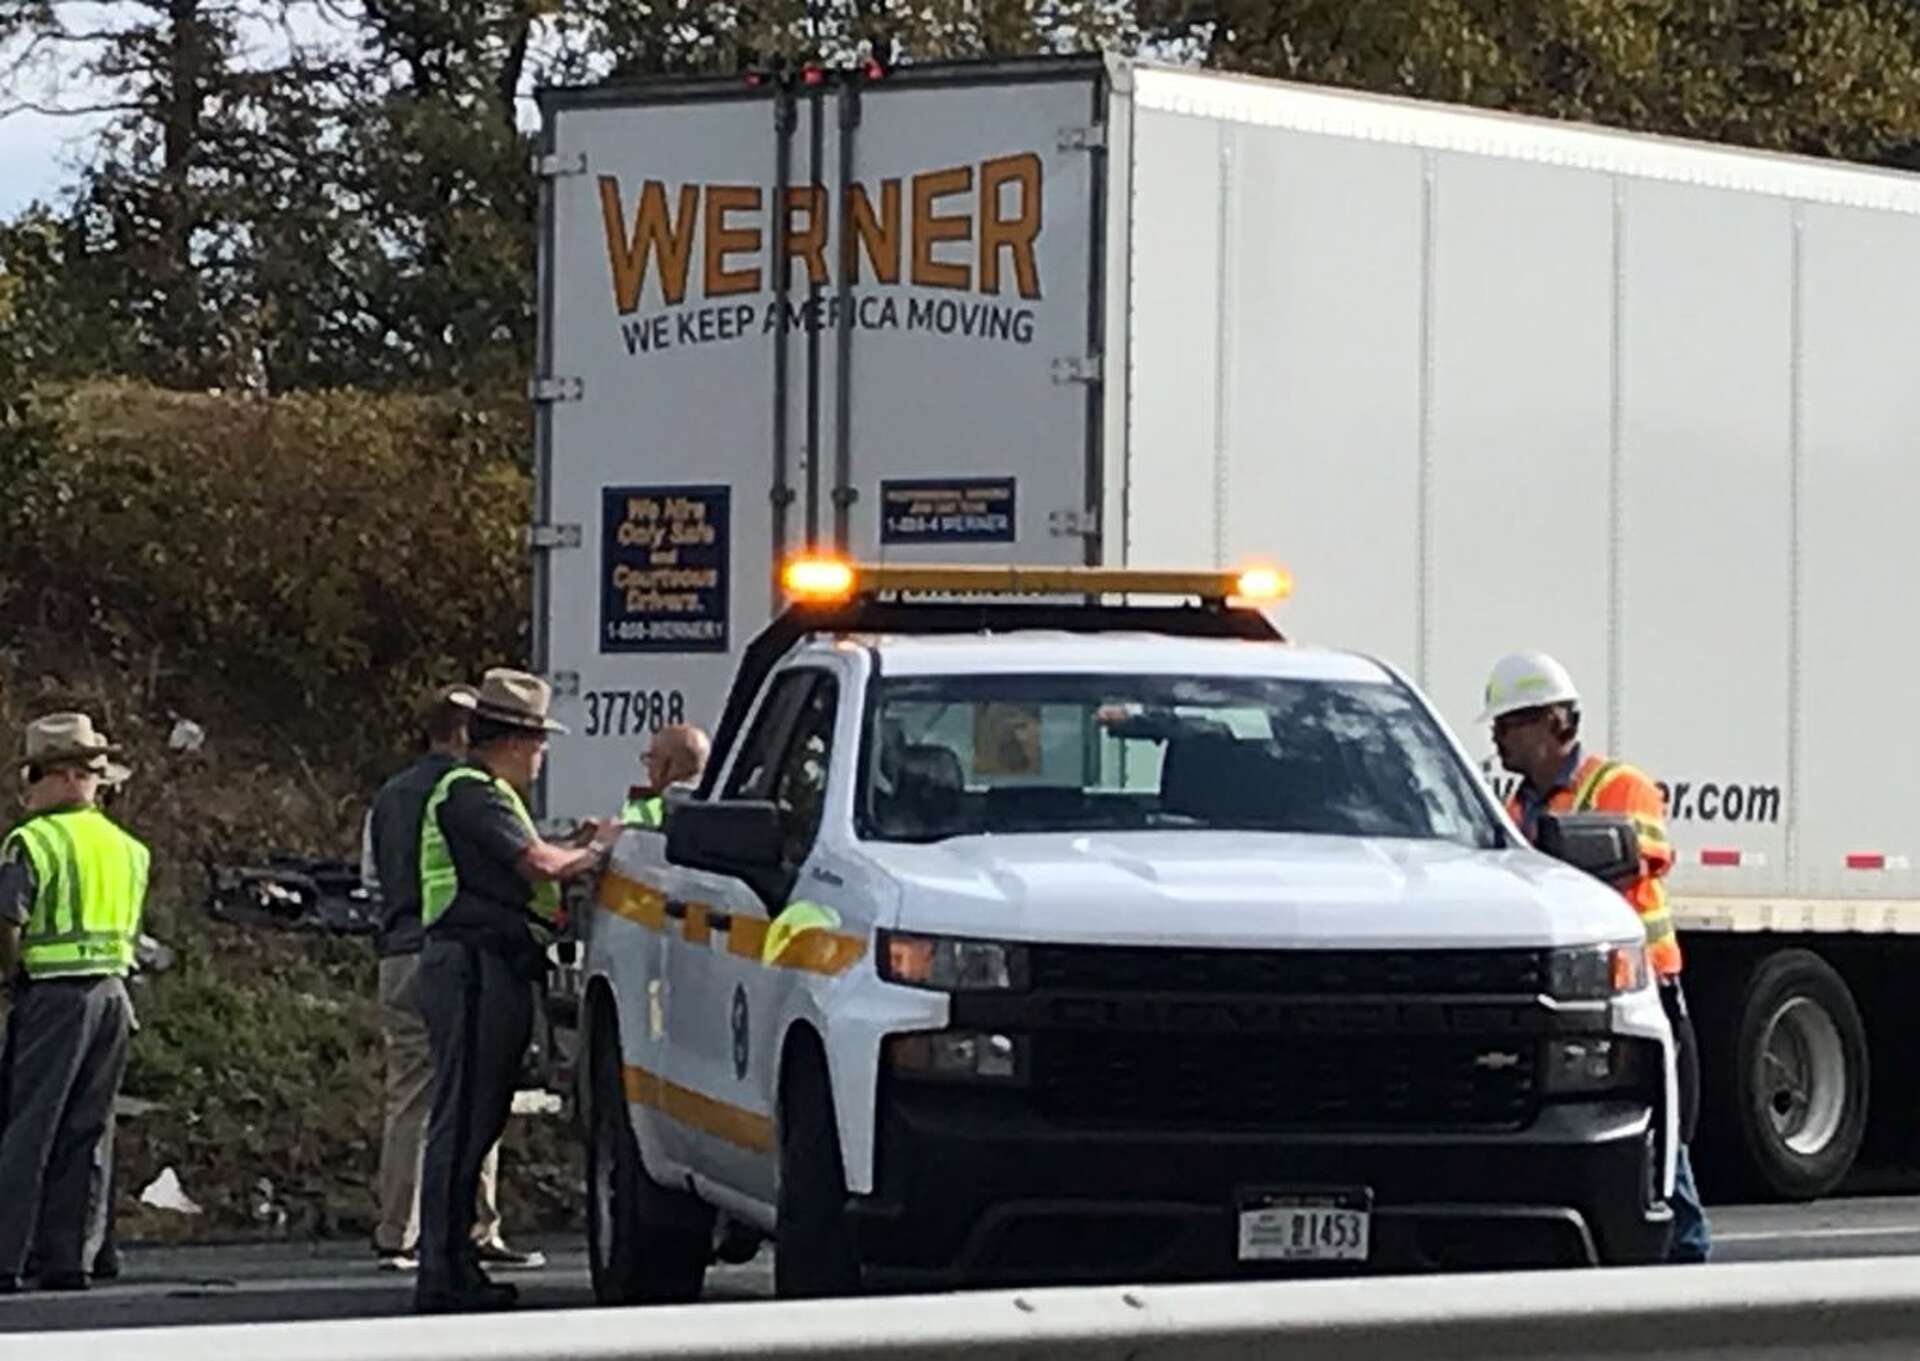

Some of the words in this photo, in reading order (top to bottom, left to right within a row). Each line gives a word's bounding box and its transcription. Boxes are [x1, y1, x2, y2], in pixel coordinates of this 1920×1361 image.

[597, 150, 1042, 315] WERNER
[622, 315, 670, 355] WE
[677, 305, 755, 344] KEEP
[907, 298, 1035, 344] MOVING
[584, 690, 685, 735] 377988
